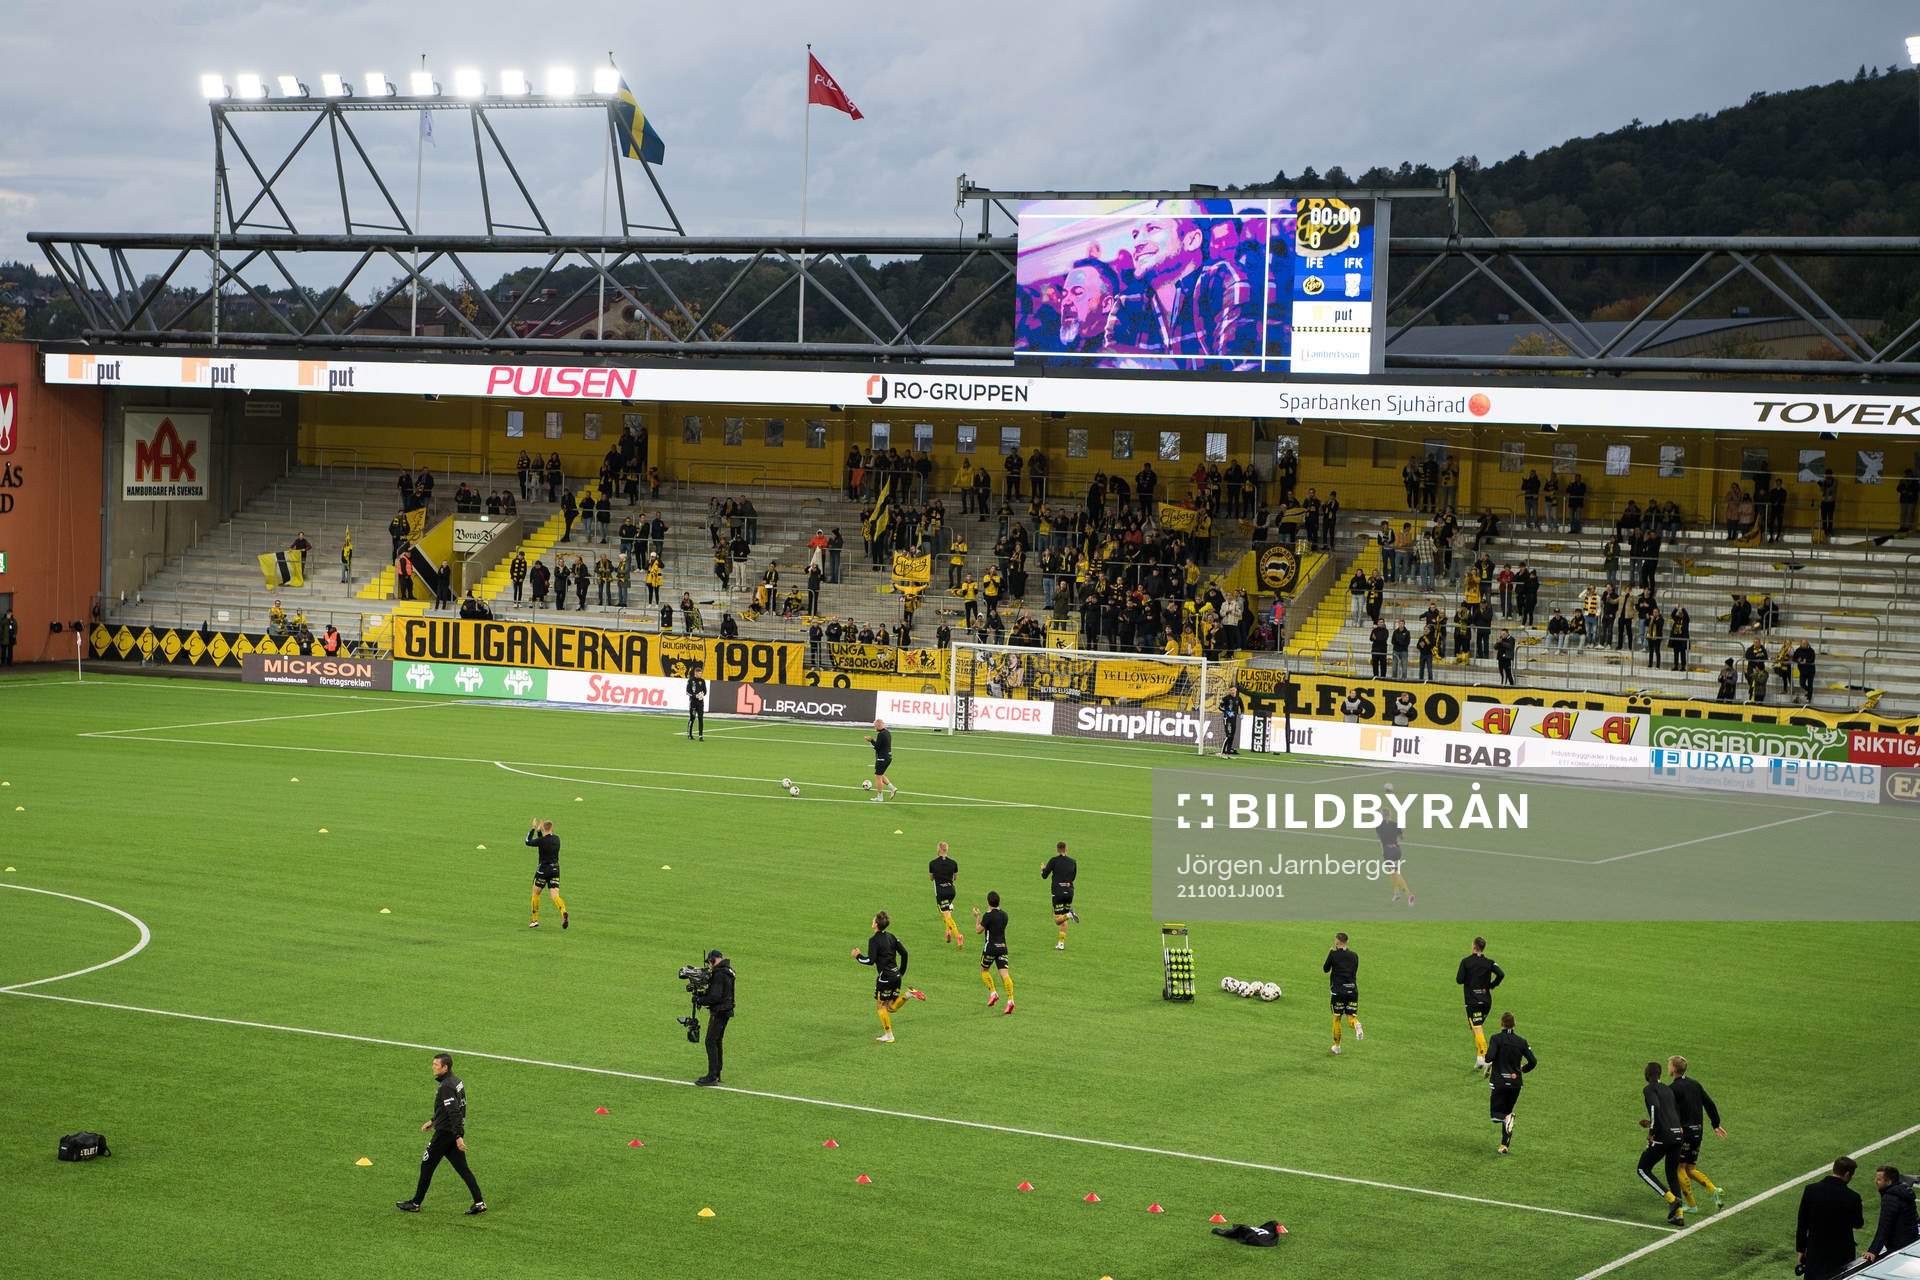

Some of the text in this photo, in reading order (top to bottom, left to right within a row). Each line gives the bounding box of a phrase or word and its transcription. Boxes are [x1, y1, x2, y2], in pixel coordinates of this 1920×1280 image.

[1310, 207, 1360, 225] 00:00
[1310, 232, 1321, 248] 0
[1349, 232, 1360, 248] 0
[1306, 258, 1324, 269] IFE
[1344, 257, 1364, 269] IFK
[487, 367, 637, 399] PULSEN
[894, 382, 1028, 403] RO-GRUPPEN
[1279, 391, 1466, 416] Sparbanken Sjuhärad
[135, 417, 197, 482] MAX
[127, 485, 203, 497] HAMBURGARE PÅ SVENSKA
[405, 620, 648, 674] GULIGANERNA
[714, 642, 788, 684] 1991
[319, 676, 371, 688] företagsreklam
[762, 699, 844, 717] L.BRADOR
[995, 707, 1041, 722] CIDER
[1253, 716, 1264, 752] SELECT
[1659, 730, 1820, 760] CASHBUDDY
[1853, 736, 1920, 756] RIKTIG
[1445, 743, 1511, 768] IBAB
[1686, 751, 1754, 775] UBAB
[1805, 761, 1875, 785] UBAB
[1723, 777, 1746, 790] Betong
[1746, 778, 1755, 789] AB
[1843, 787, 1865, 800] Betong
[1866, 789, 1876, 800] AB
